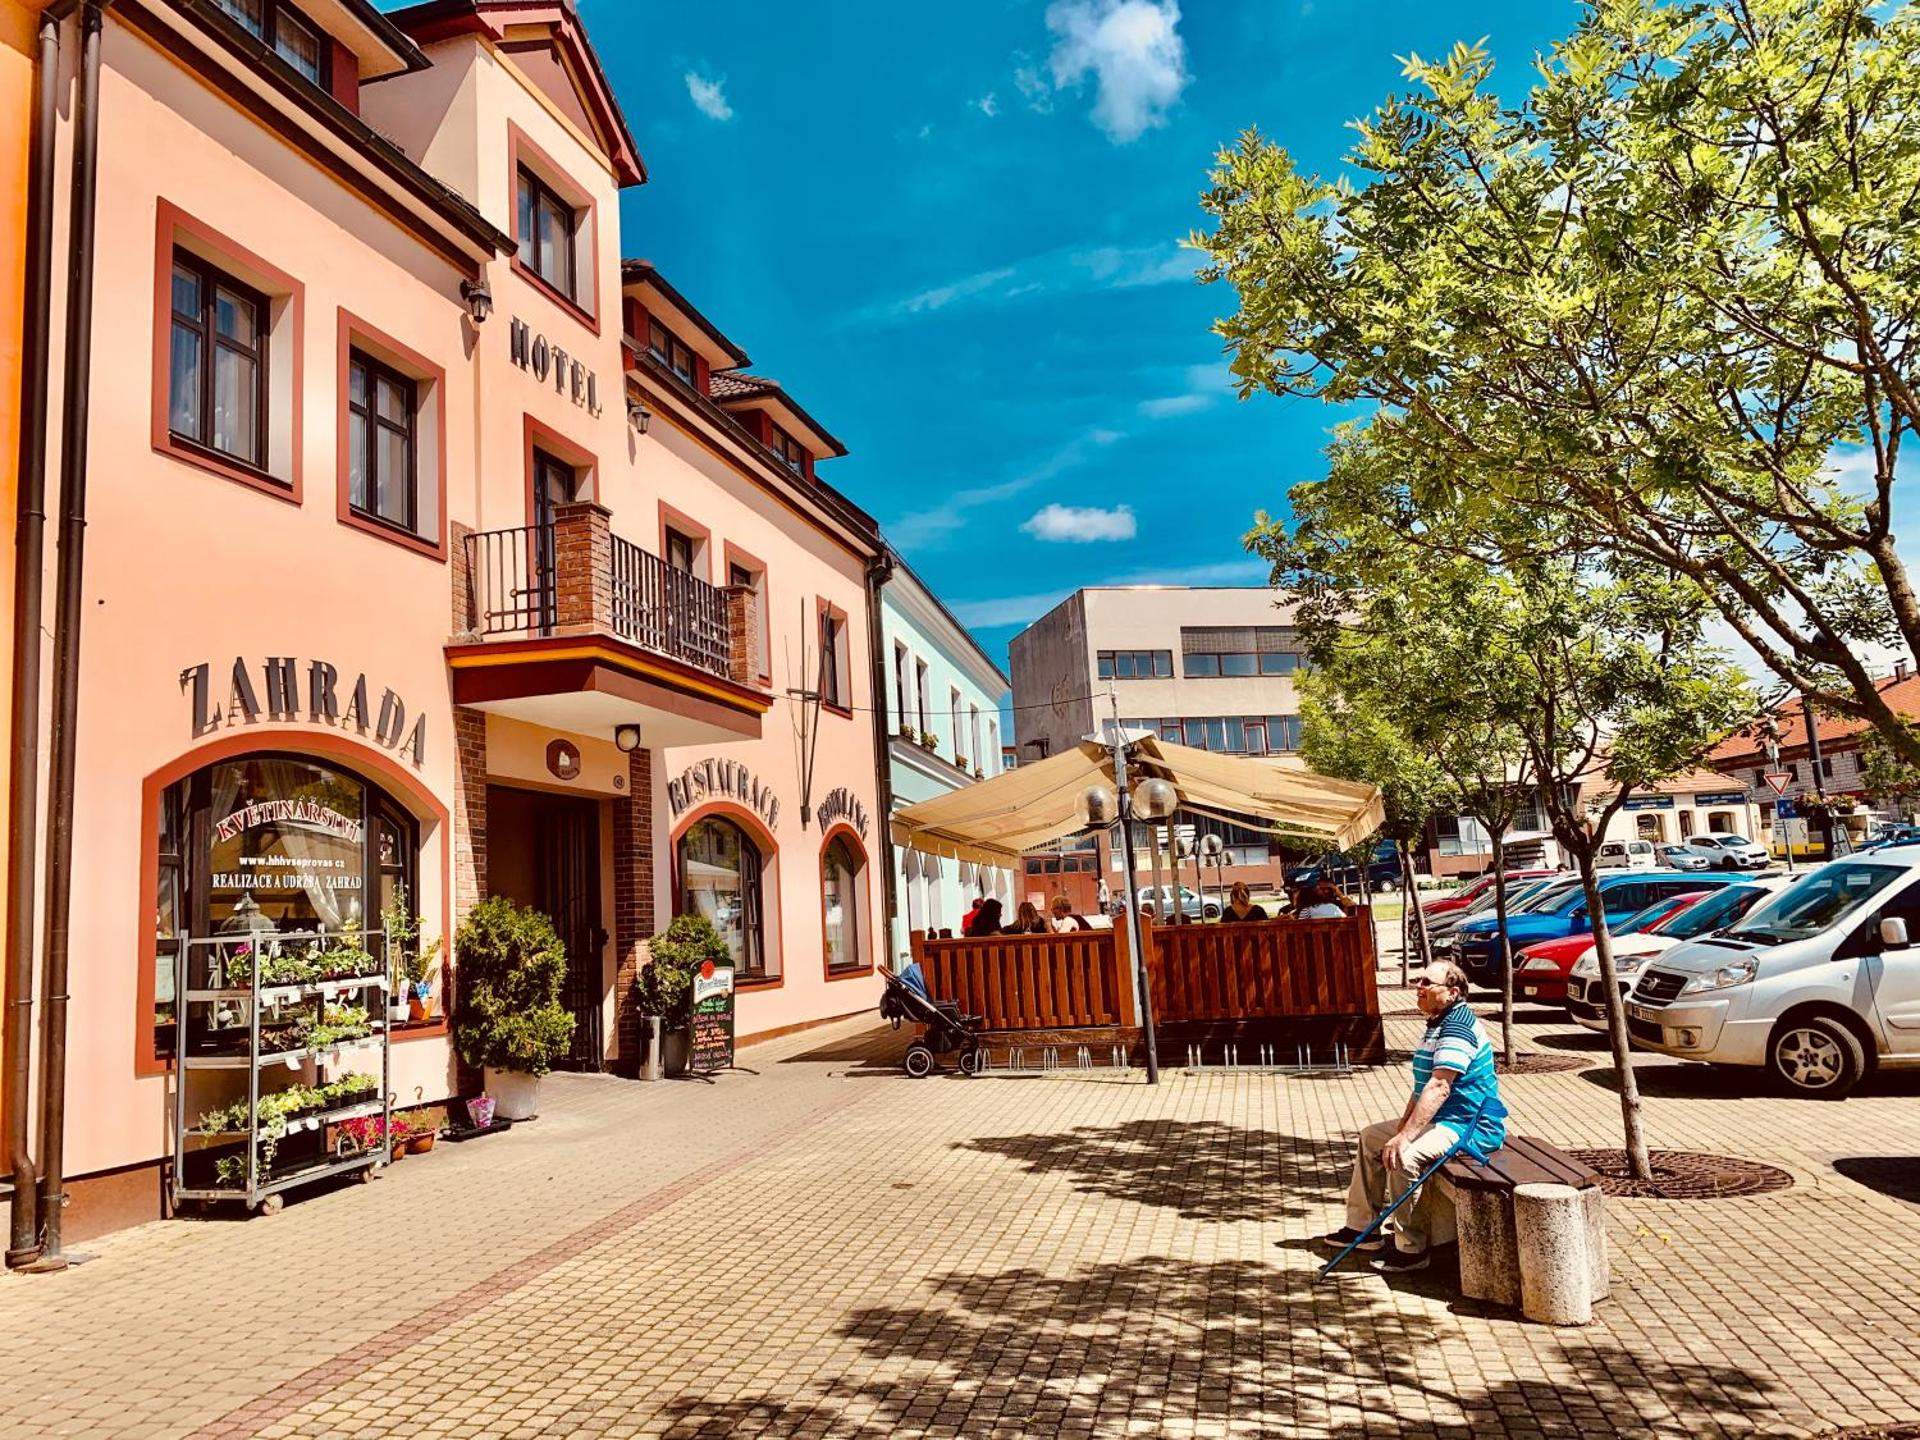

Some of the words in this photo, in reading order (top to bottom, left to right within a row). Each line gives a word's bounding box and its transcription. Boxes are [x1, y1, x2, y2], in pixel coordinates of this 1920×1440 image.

[510, 314, 602, 420] HOTEL
[180, 657, 426, 770] ZAHRADA
[216, 794, 361, 843] KVĚTINÁŘSTVÍ
[667, 757, 781, 833] RESTAURACE
[212, 873, 272, 888] REALIZACE
[274, 876, 281, 888] A
[326, 875, 362, 889] ZAHRAD
